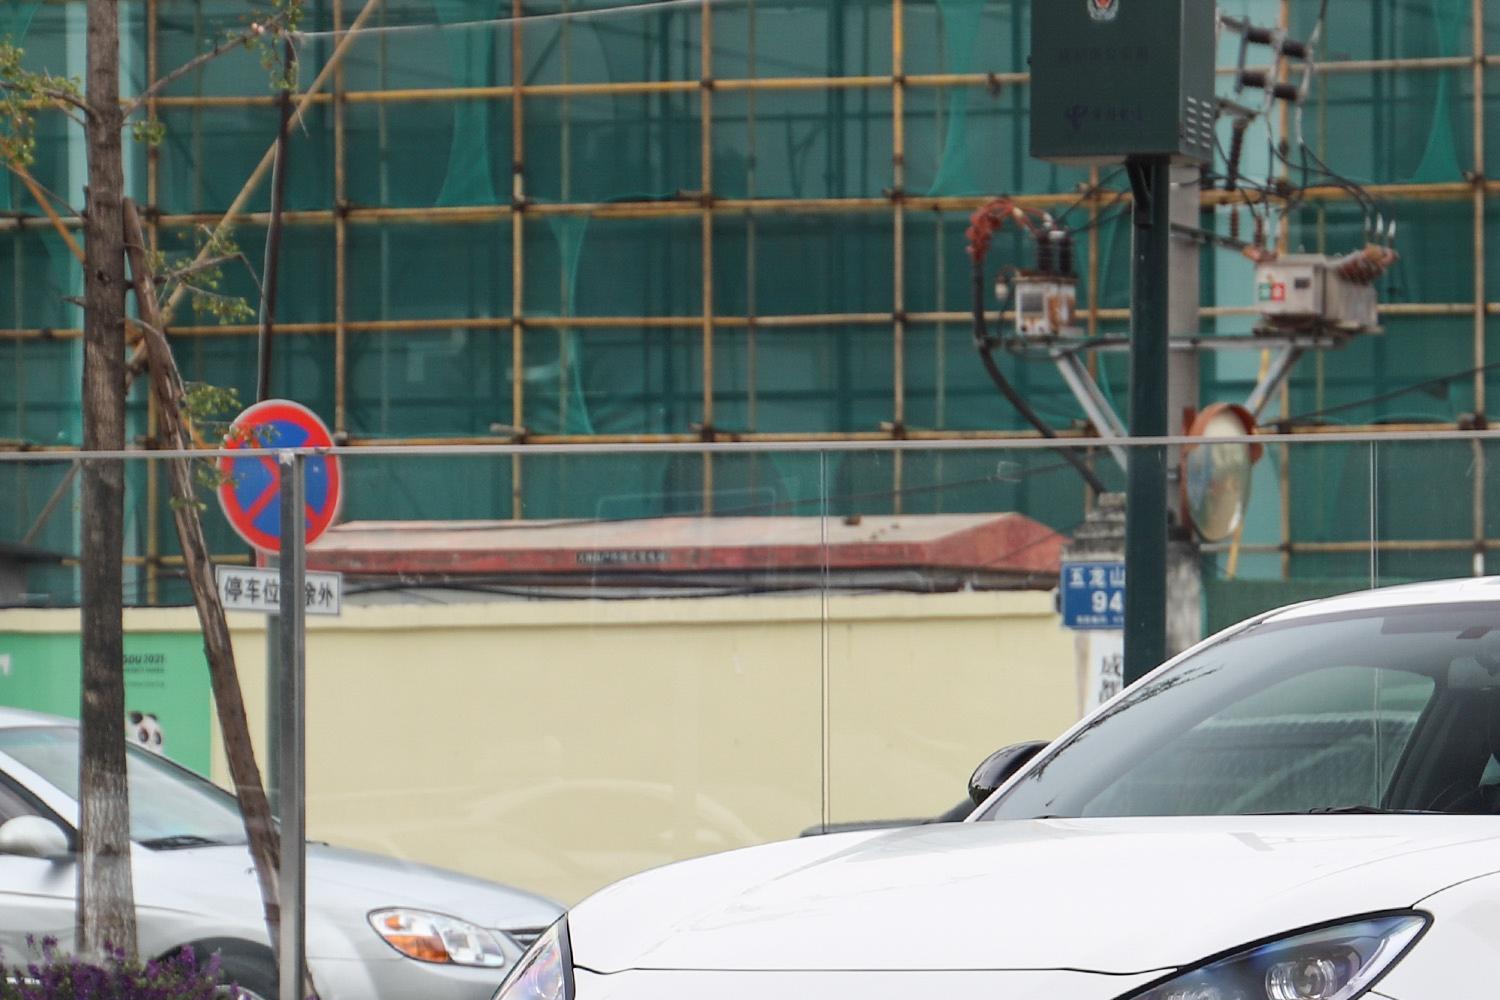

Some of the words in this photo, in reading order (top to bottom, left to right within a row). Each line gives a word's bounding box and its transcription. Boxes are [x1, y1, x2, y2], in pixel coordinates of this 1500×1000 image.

[224, 576, 334, 607] 停车位除外
